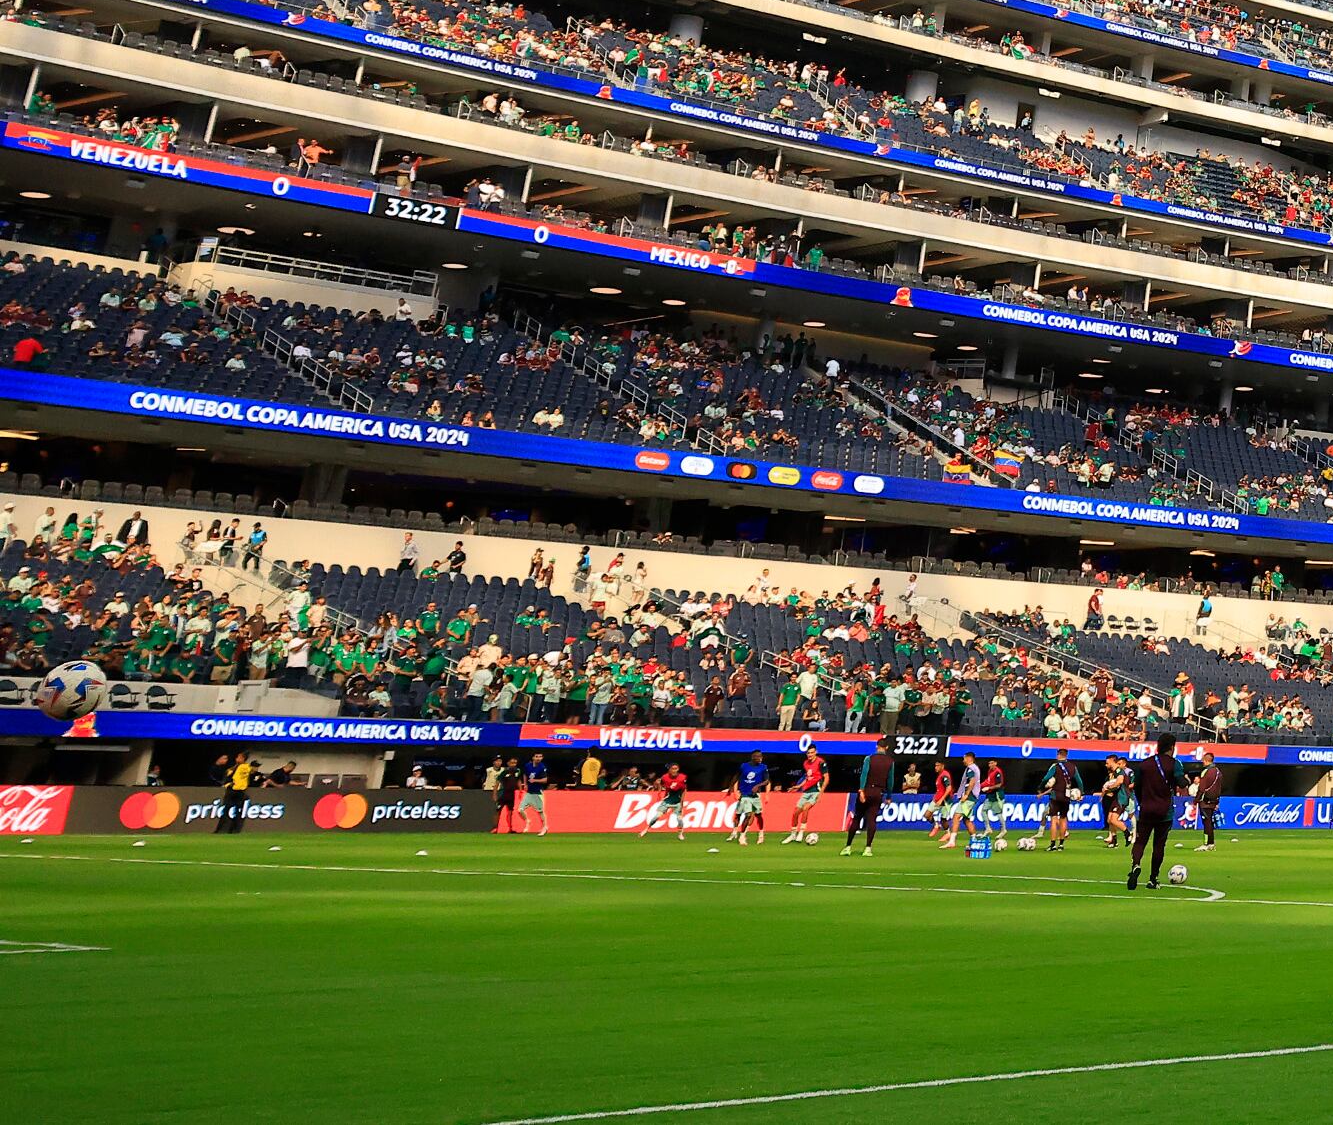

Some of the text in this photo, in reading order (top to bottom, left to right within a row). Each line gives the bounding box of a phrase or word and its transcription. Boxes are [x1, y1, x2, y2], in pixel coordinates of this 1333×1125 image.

[71, 139, 290, 196] VENEZUELA 0
[384, 198, 447, 225] 32:22
[533, 226, 711, 269] 0 MEXICO
[982, 304, 1179, 346] CONMEBOL COPA AMERICA USA 2024
[129, 391, 469, 447] CONMEBOL COPA AMERICA USA 2024
[1022, 495, 1240, 531] CONMEBOL COPA AMERICA USA 2024
[190, 718, 482, 741] CONMEBOL COPA AMERICA USA 2024
[600, 728, 812, 753] VENEZUELA 0
[893, 736, 939, 755] 32:22
[1021, 739, 1034, 757] 0
[371, 800, 461, 824] priceless
[1234, 802, 1303, 826] Michelob
